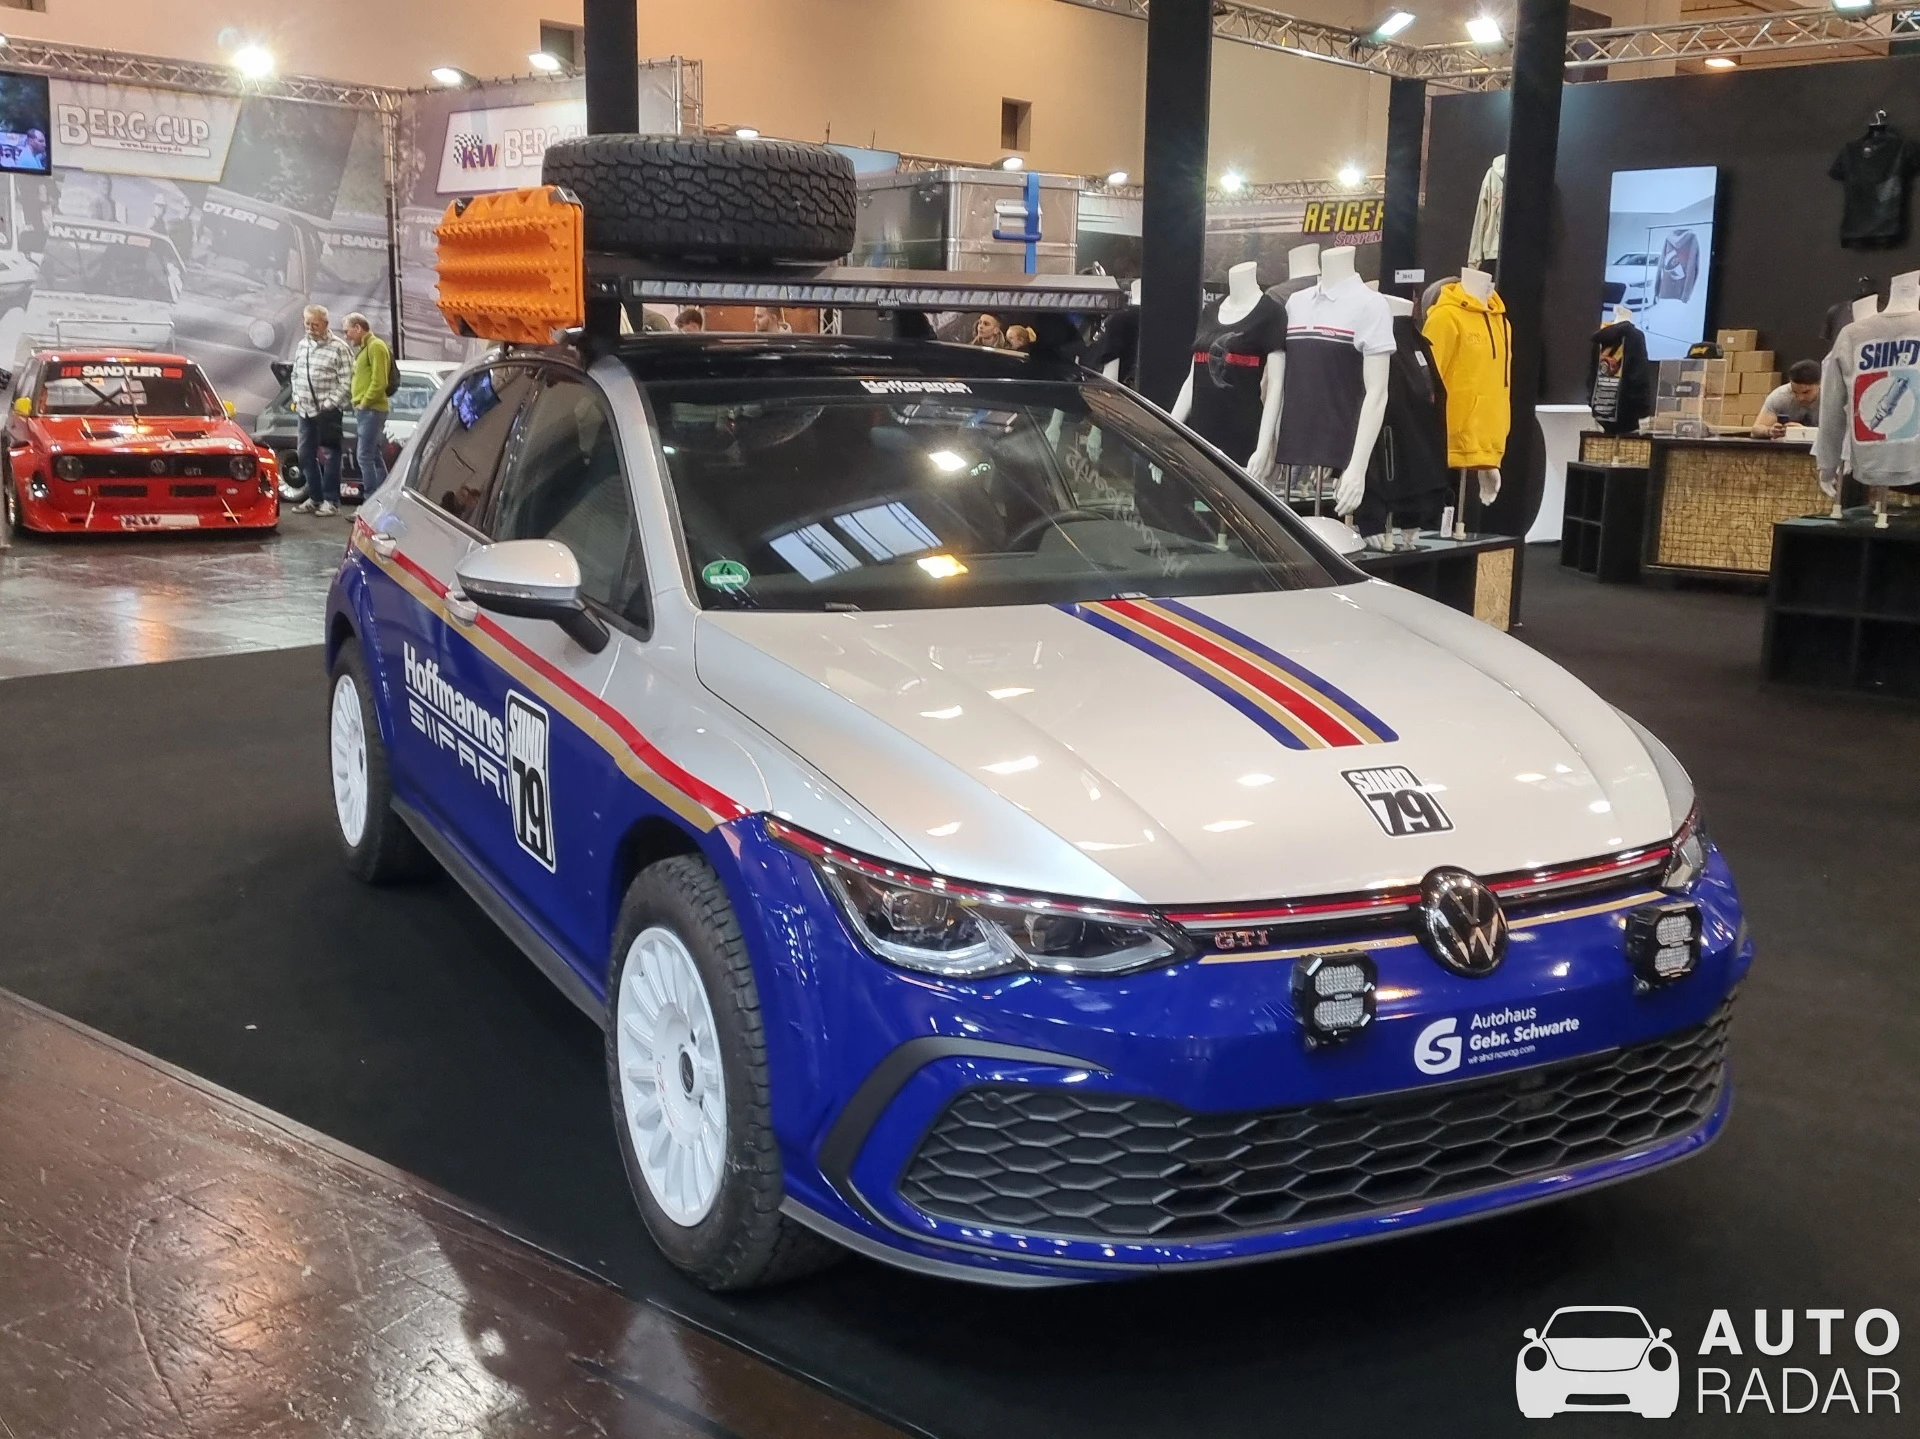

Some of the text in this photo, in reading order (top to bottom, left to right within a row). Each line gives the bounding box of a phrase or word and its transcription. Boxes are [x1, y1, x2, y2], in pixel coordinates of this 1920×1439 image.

[462, 144, 497, 169] KW
[203, 201, 258, 224] DTLER
[50, 225, 127, 244] ANDTLER
[342, 234, 388, 250] SANDT
[1334, 231, 1383, 246] SUSPEN
[82, 366, 163, 377] SANDTLER
[122, 515, 161, 527] KW
[404, 641, 504, 756] Hoffmanns
[512, 755, 548, 859] 79
[1367, 789, 1442, 835] 79
[1214, 929, 1269, 950] GTI
[1470, 1007, 1537, 1031] Autohaus
[1469, 1017, 1580, 1051] Gebr. Schwarte
